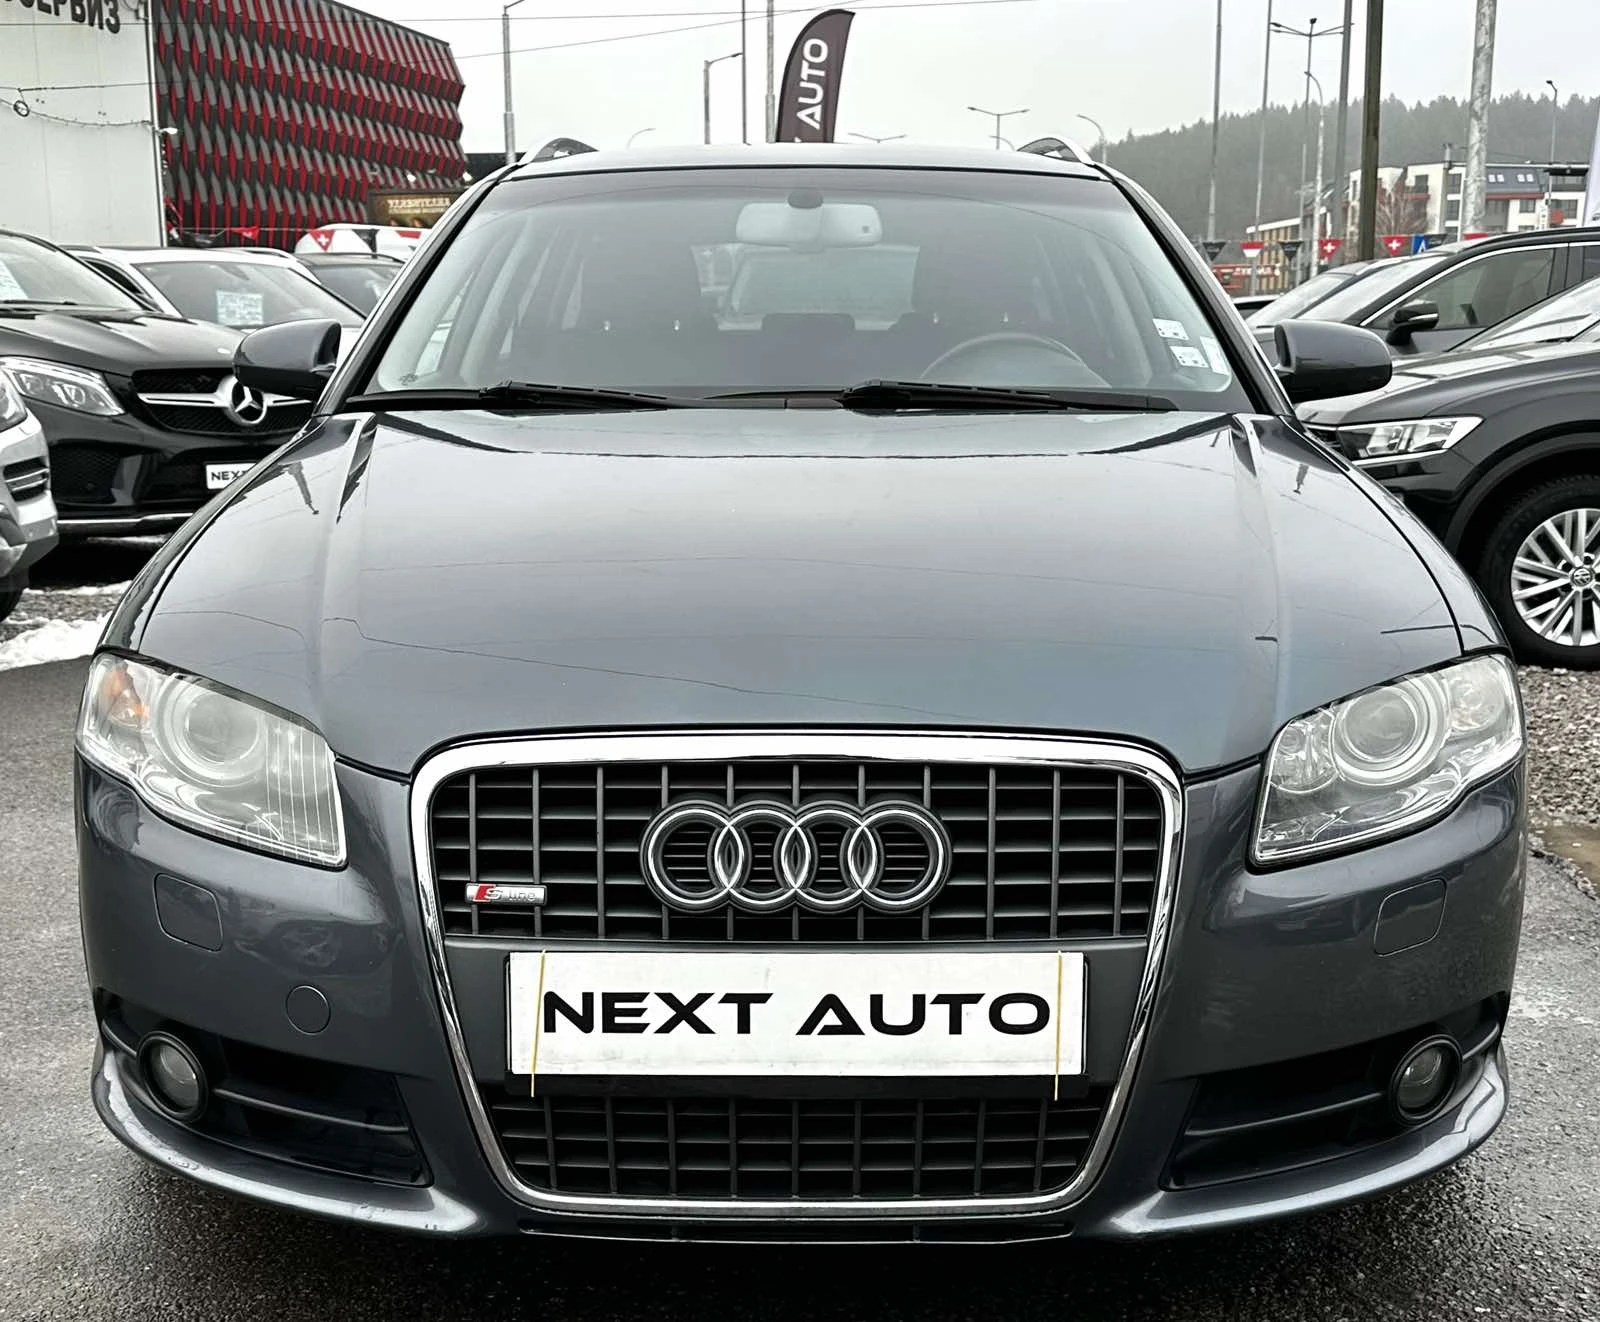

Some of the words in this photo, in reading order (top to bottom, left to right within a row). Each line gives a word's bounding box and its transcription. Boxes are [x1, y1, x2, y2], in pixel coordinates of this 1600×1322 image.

[796, 38, 828, 130] AUTO
[211, 470, 247, 481] NEX
[543, 991, 773, 1035] NEXT
[795, 992, 1050, 1036] AUTO
